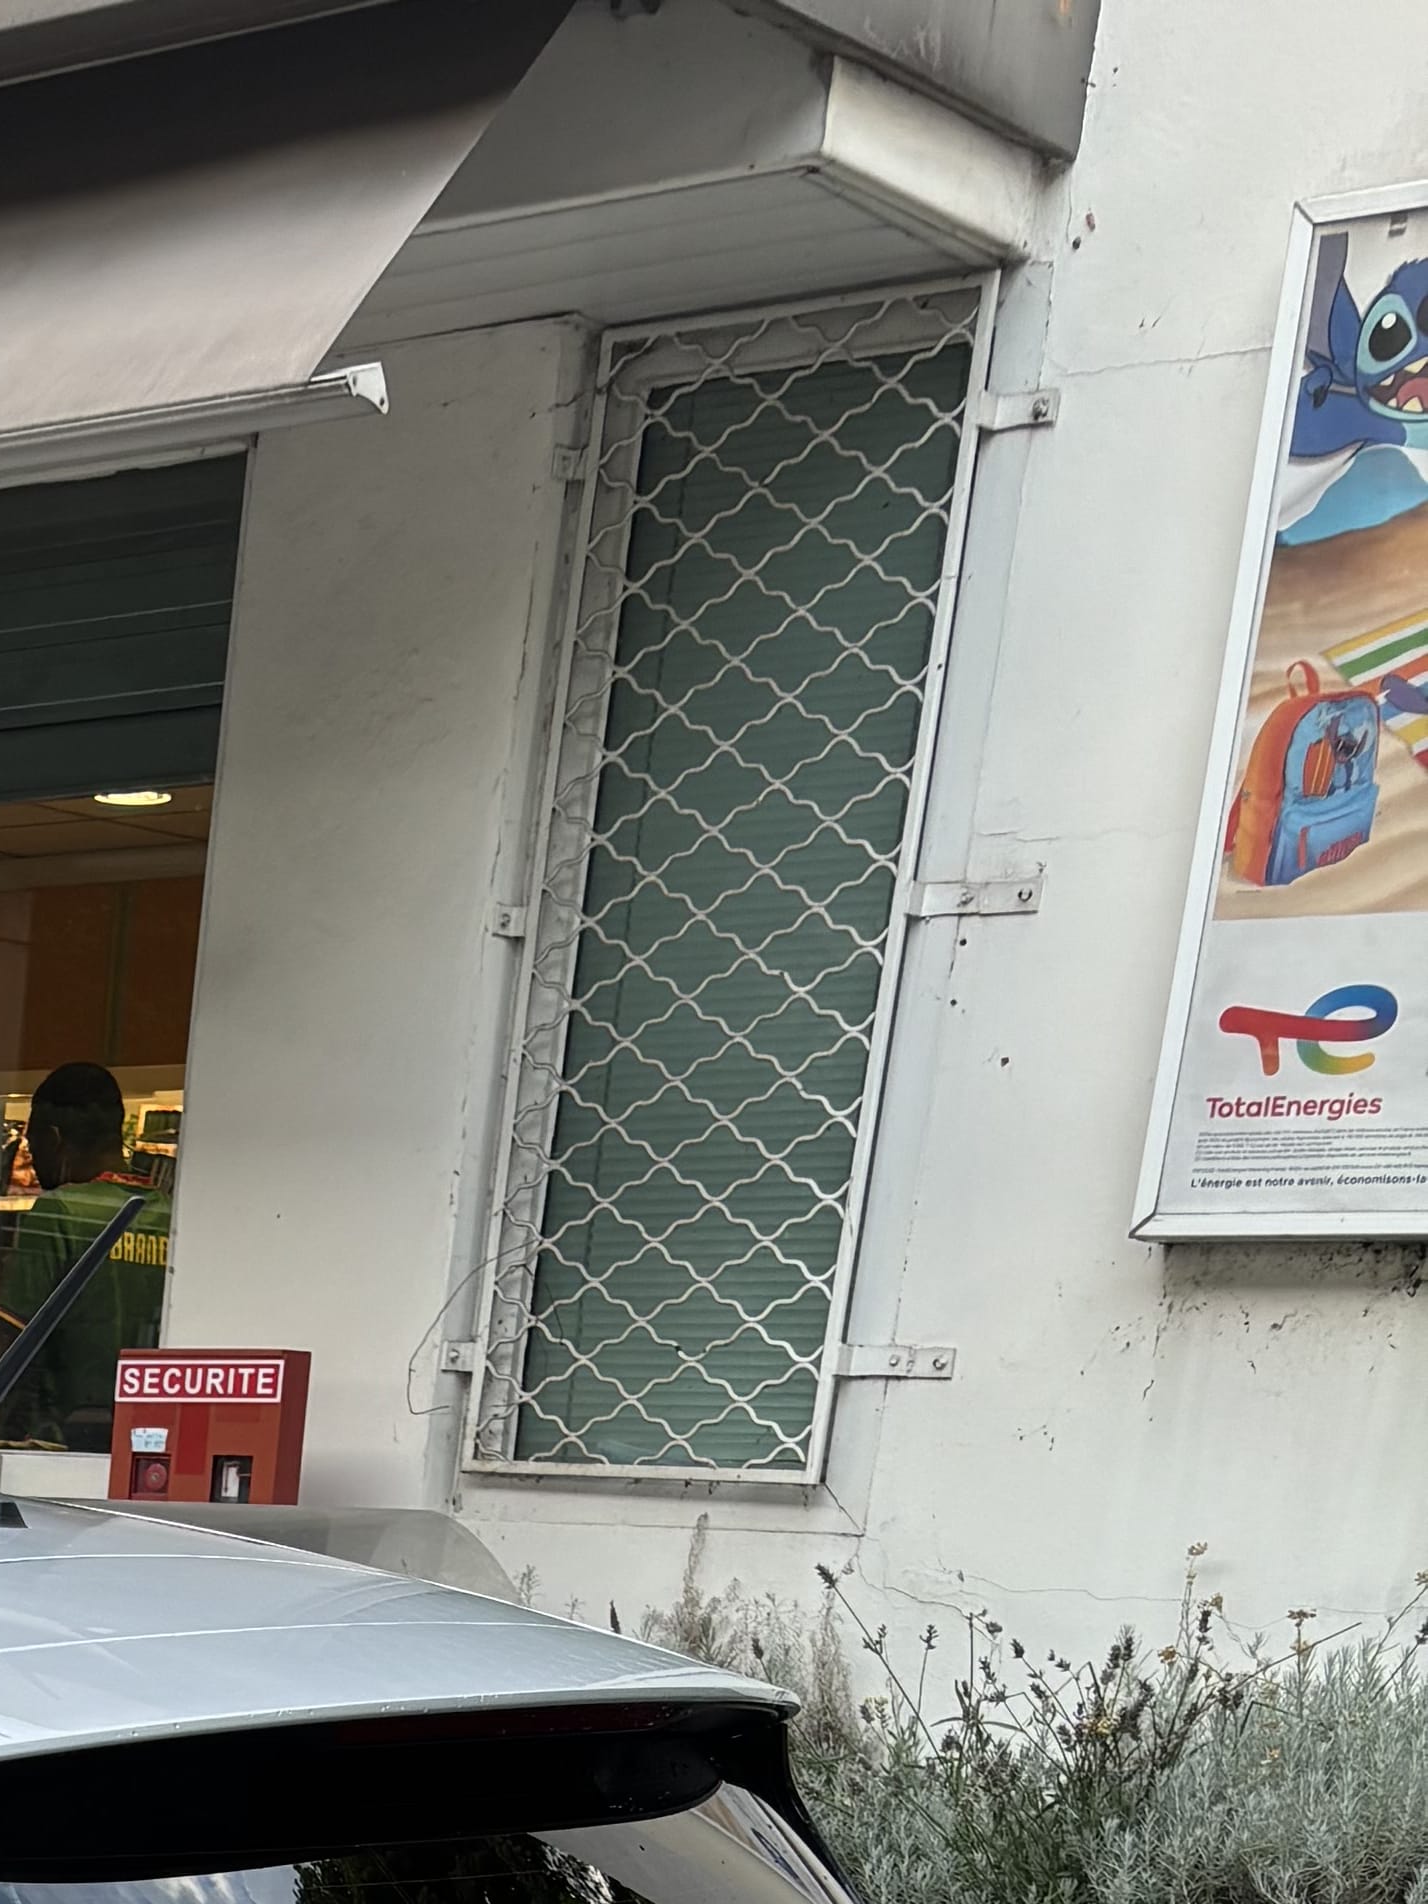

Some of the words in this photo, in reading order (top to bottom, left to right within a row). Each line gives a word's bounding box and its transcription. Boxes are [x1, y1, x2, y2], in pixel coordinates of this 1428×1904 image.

[1206, 1092, 1383, 1121] TotalEnergies
[1191, 1175, 1243, 1190] L'énergie
[1245, 1178, 1262, 1188] est
[1265, 1176, 1295, 1188] notre
[123, 1366, 275, 1395] SECURITE
